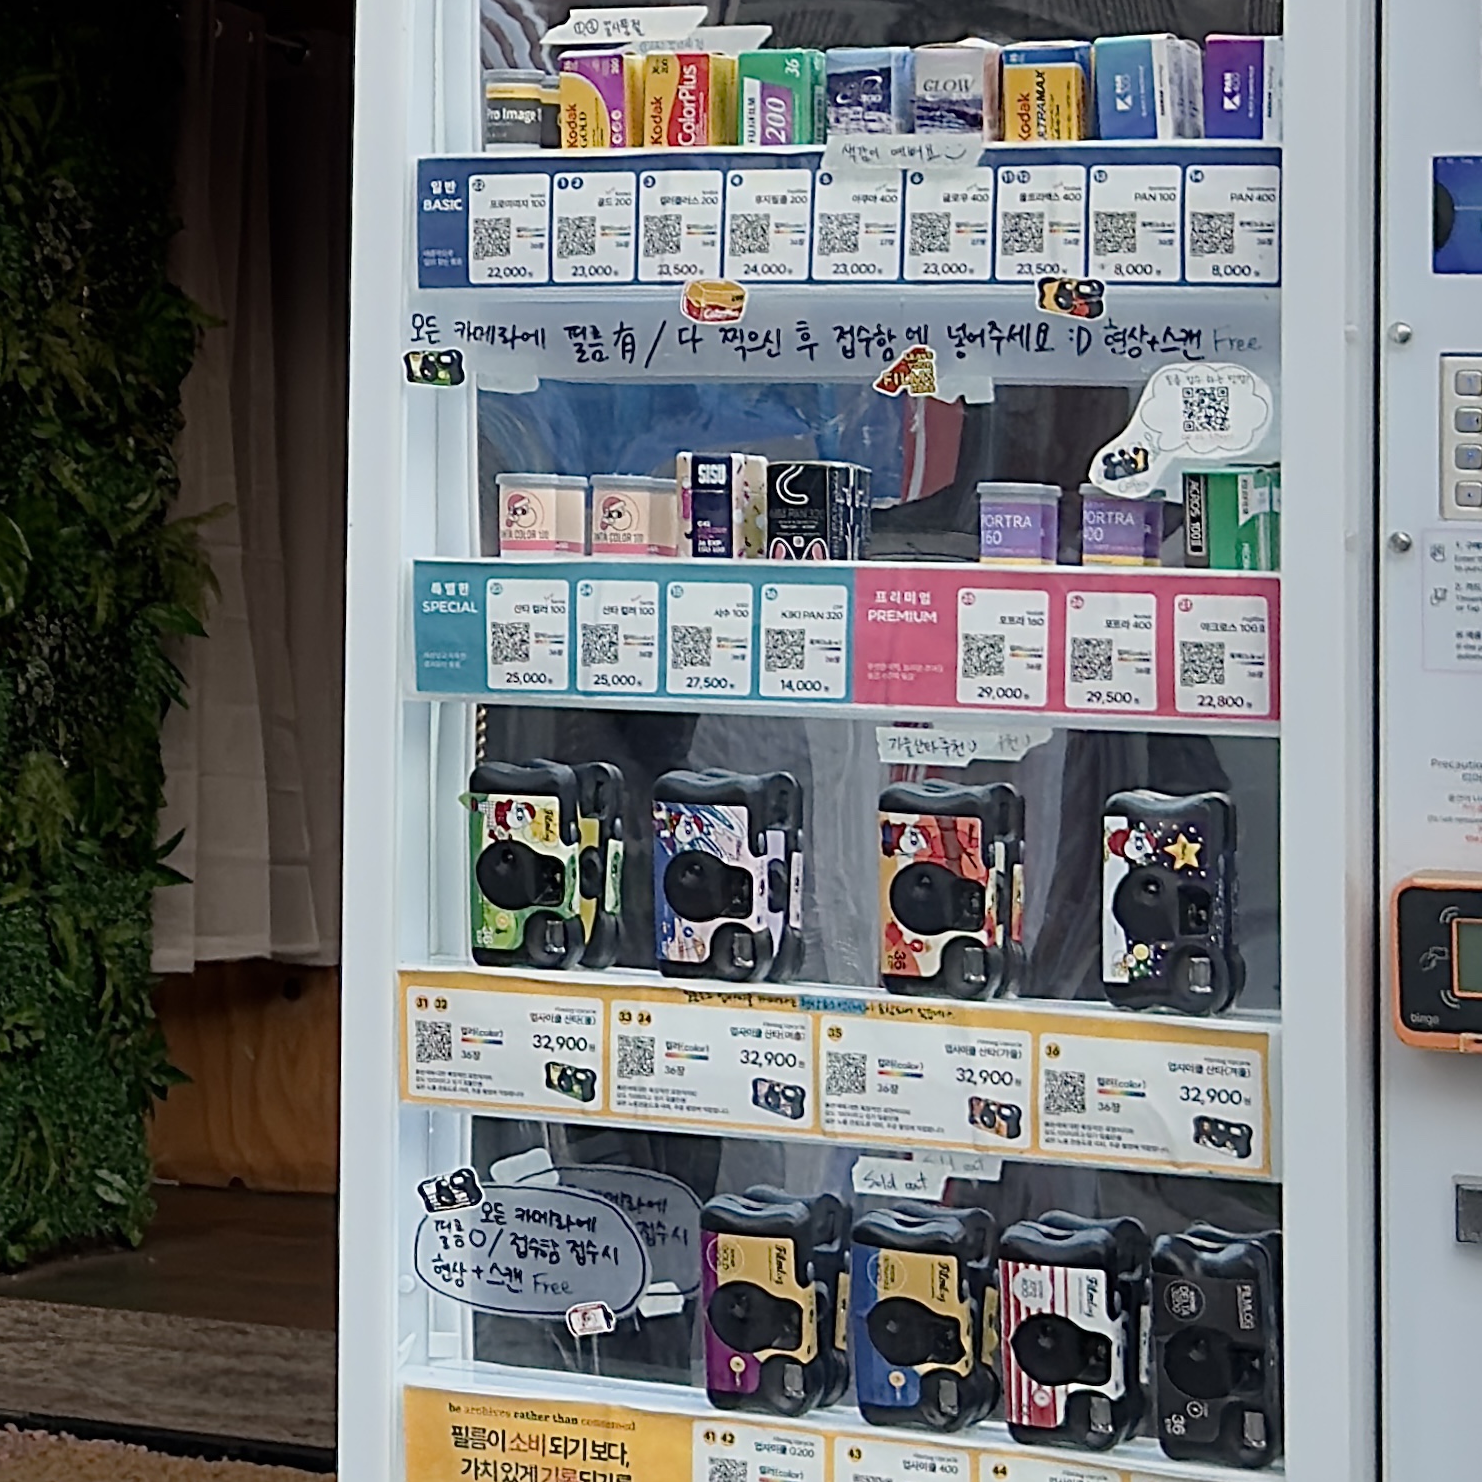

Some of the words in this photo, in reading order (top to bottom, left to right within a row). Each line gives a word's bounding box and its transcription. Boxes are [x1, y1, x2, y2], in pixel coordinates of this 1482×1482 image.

[923, 78, 975, 92] GLOW
[677, 64, 698, 146] ColorPlus
[502, 107, 536, 123] Image
[651, 96, 663, 146] Kodak
[766, 97, 786, 144] 200
[567, 103, 577, 148] Kodak
[615, 198, 632, 207] 200
[701, 196, 719, 205] 200
[790, 195, 808, 204] 200
[879, 194, 898, 203] 400
[970, 194, 989, 202] 400
[1062, 192, 1082, 201] 400
[1135, 192, 1155, 202] PAN
[1158, 192, 1177, 202] 100
[1230, 192, 1253, 203] PAN
[1254, 193, 1276, 203] 400
[422, 198, 463, 212] BASIC
[411, 312, 441, 345] 모든
[453, 320, 546, 350] 카메라에
[678, 320, 703, 354] 다
[720, 324, 781, 362] 찍으신
[795, 320, 818, 362] 후
[947, 321, 1055, 358] 넣어주세요
[1213, 328, 1262, 353] Free
[697, 463, 726, 485] SISU
[874, 590, 931, 606] 프리미엄
[421, 600, 478, 614] SPECIAL
[550, 604, 566, 614] 100
[639, 605, 655, 615] 100
[731, 608, 749, 617] 100
[803, 611, 825, 620] PAN
[867, 609, 938, 624] PREMIUM
[863, 1169, 898, 1191] Sold
[904, 1171, 928, 1191] out
[481, 1202, 507, 1226] 모든
[514, 1207, 597, 1234] 카메라에
[431, 1254, 468, 1287] 현상
[486, 1263, 524, 1294] 스캔
[532, 1273, 573, 1296] Free
[449, 1403, 461, 1413] be
[513, 1410, 551, 1423] rather
[552, 1413, 578, 1425] than
[702, 1430, 717, 1446] 41
[451, 1425, 506, 1453] 필름이
[509, 1432, 546, 1457] 소비
[548, 1435, 588, 1461] 되기
[590, 1440, 630, 1468] 보다,
[461, 1457, 498, 1482] 가치
[938, 1463, 959, 1475] 400
[992, 1463, 1007, 1479] 44
